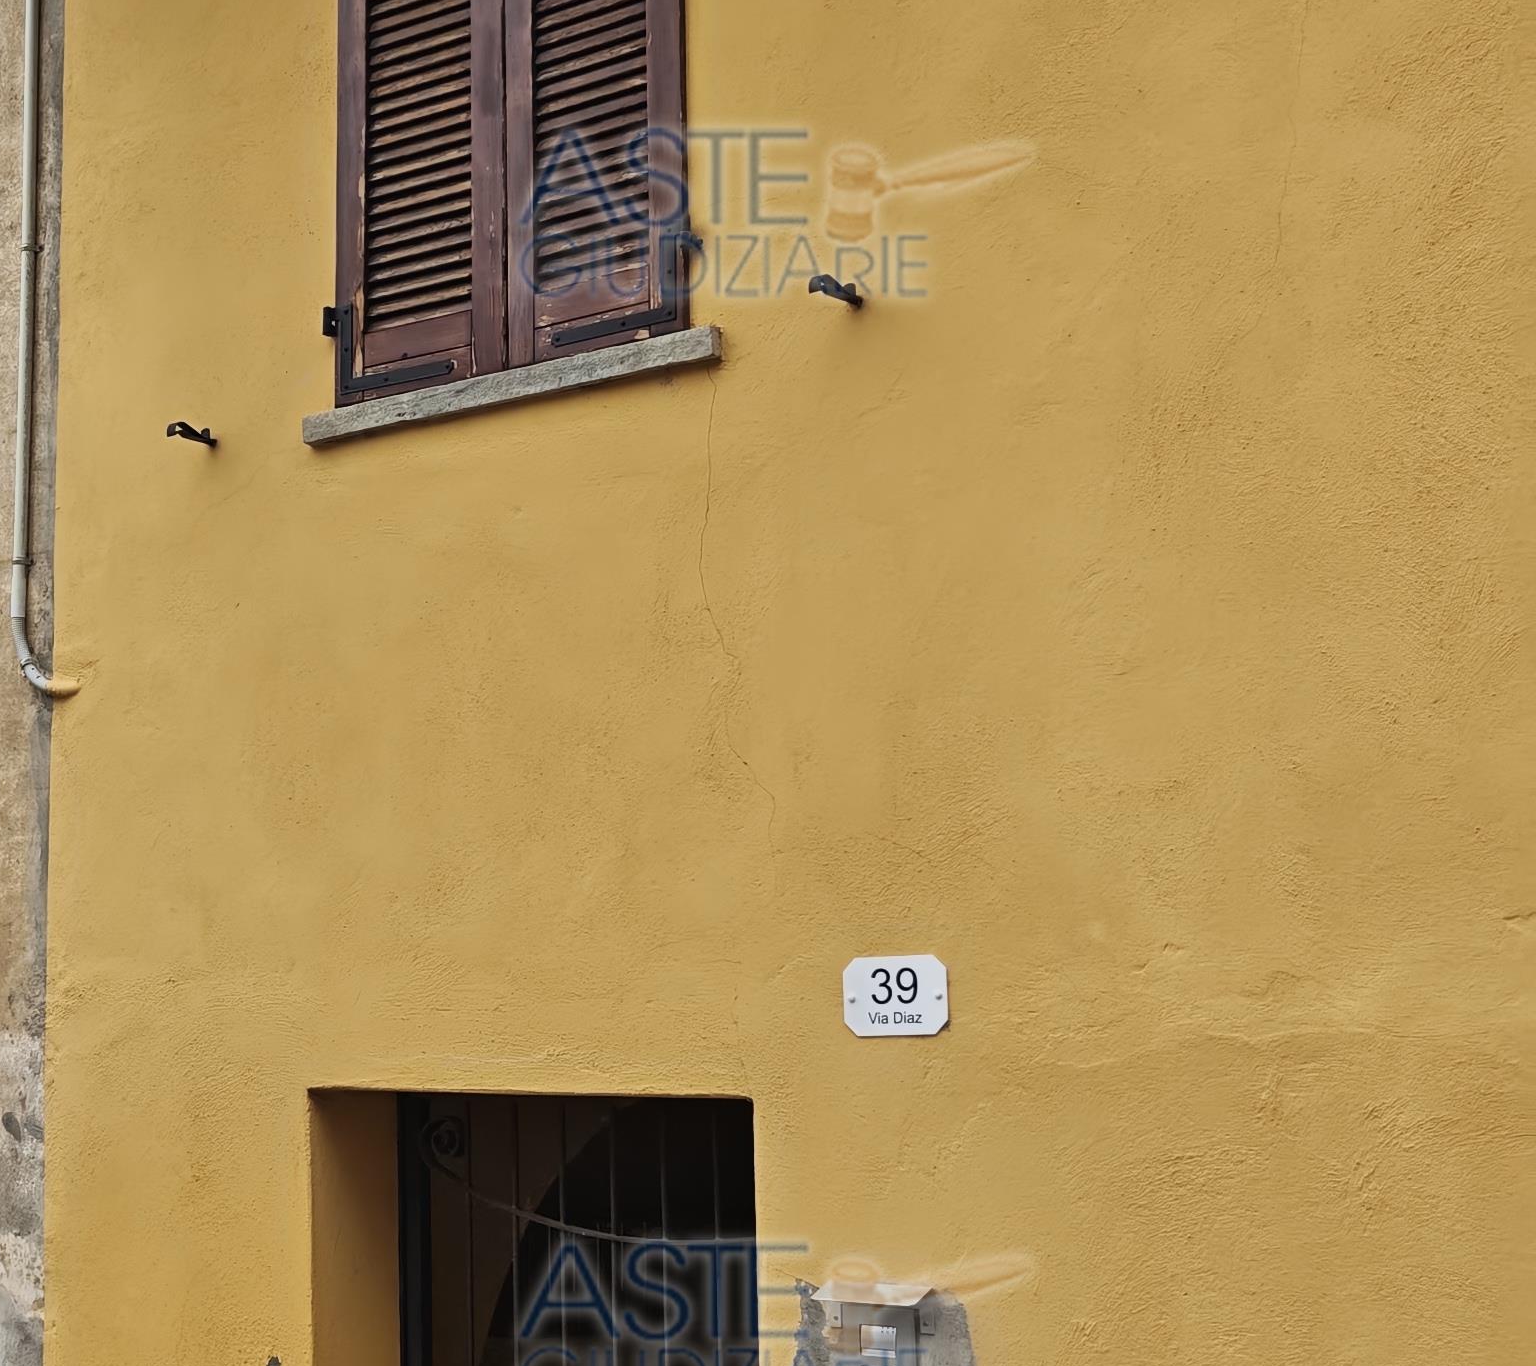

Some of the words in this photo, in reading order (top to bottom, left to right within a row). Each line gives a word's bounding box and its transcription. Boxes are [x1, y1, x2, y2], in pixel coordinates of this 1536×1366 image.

[870, 967, 918, 1005] 39
[868, 1011, 889, 1025] Via
[893, 1011, 923, 1024] Diaz
